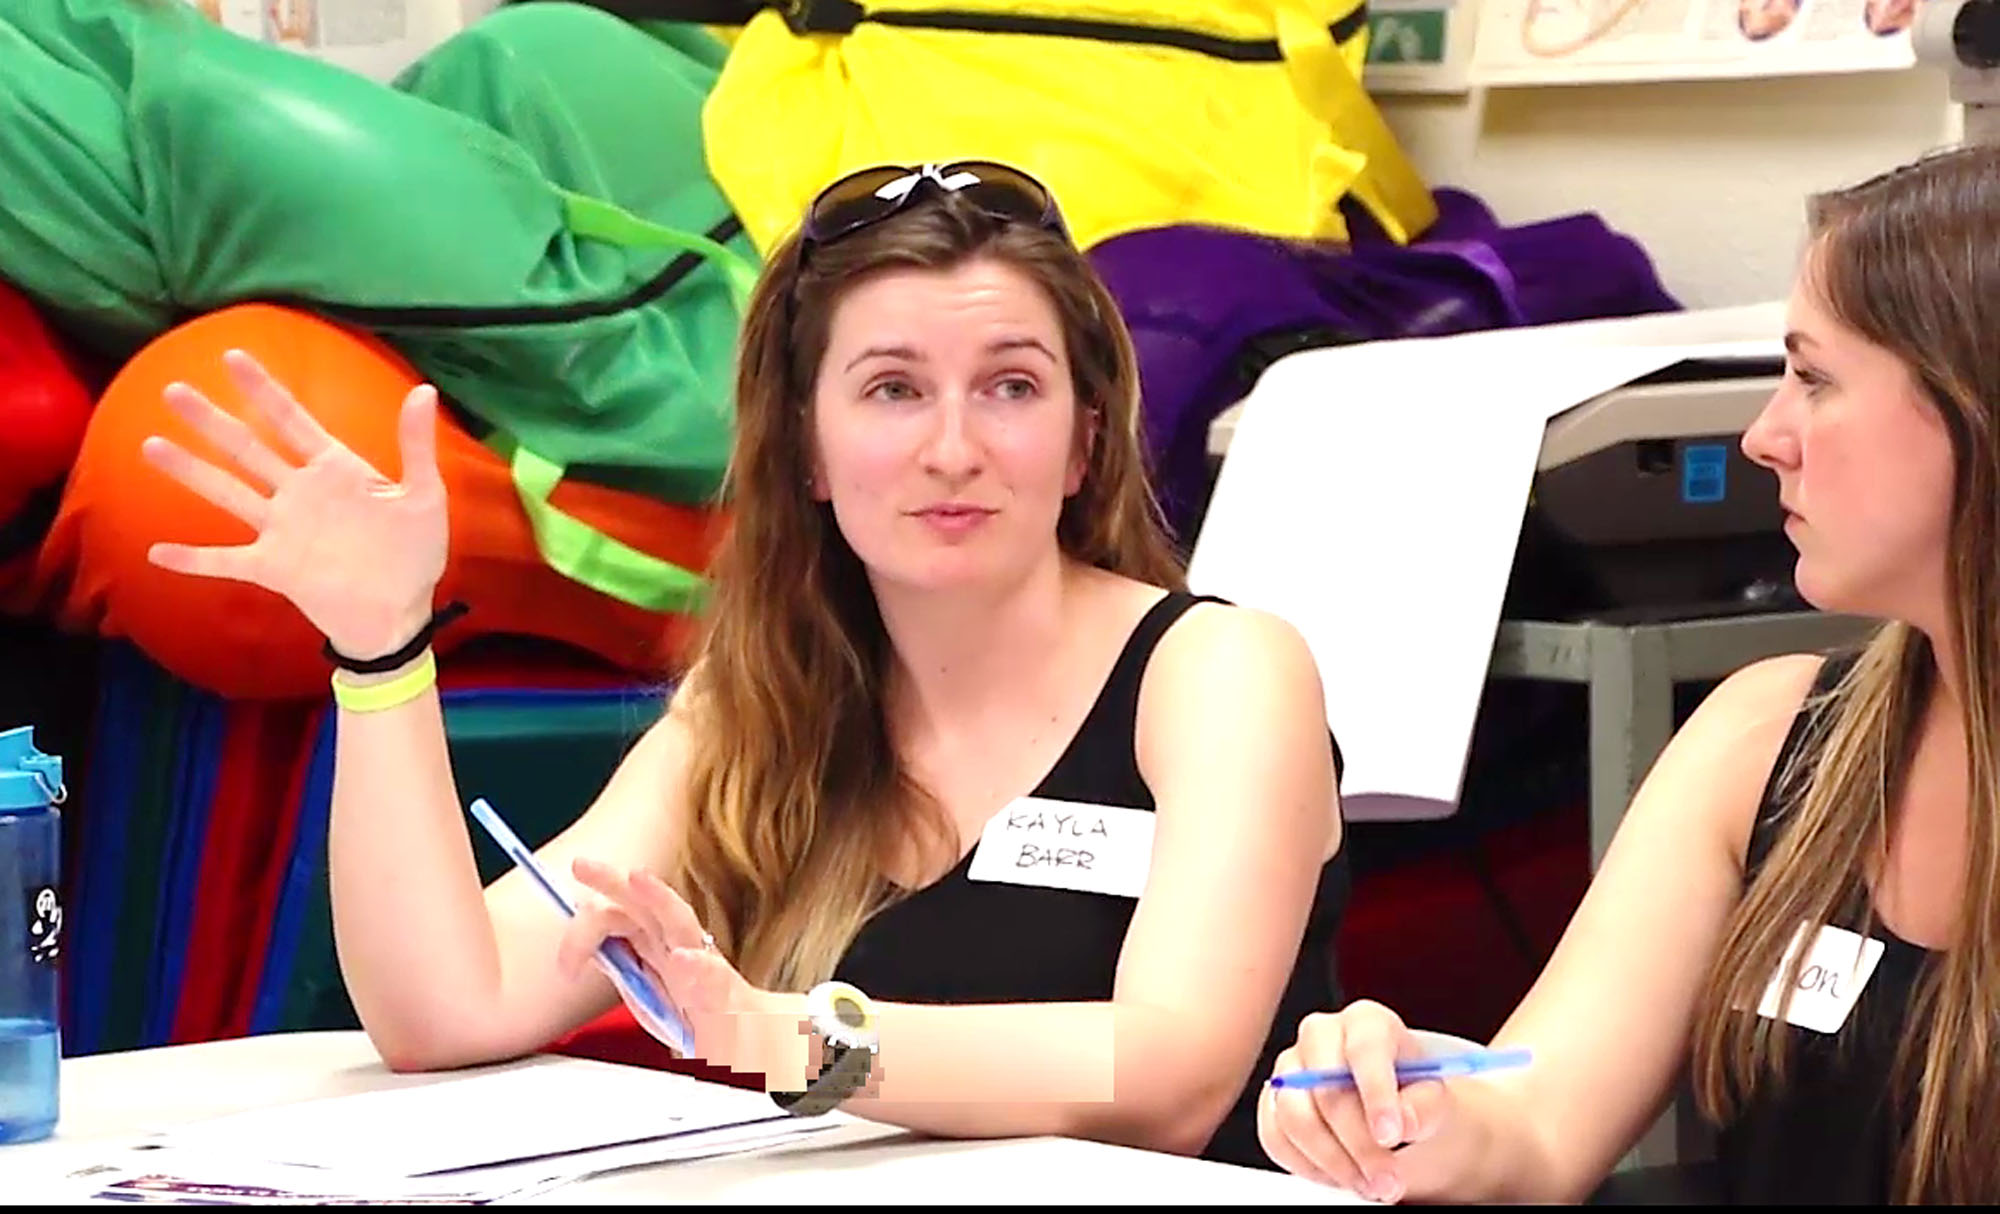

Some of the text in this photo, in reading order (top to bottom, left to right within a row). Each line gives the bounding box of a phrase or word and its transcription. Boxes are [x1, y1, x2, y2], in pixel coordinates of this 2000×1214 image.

[1006, 812, 1108, 838] KAYLA
[1015, 843, 1095, 870] BARR
[1798, 965, 1840, 999] on
